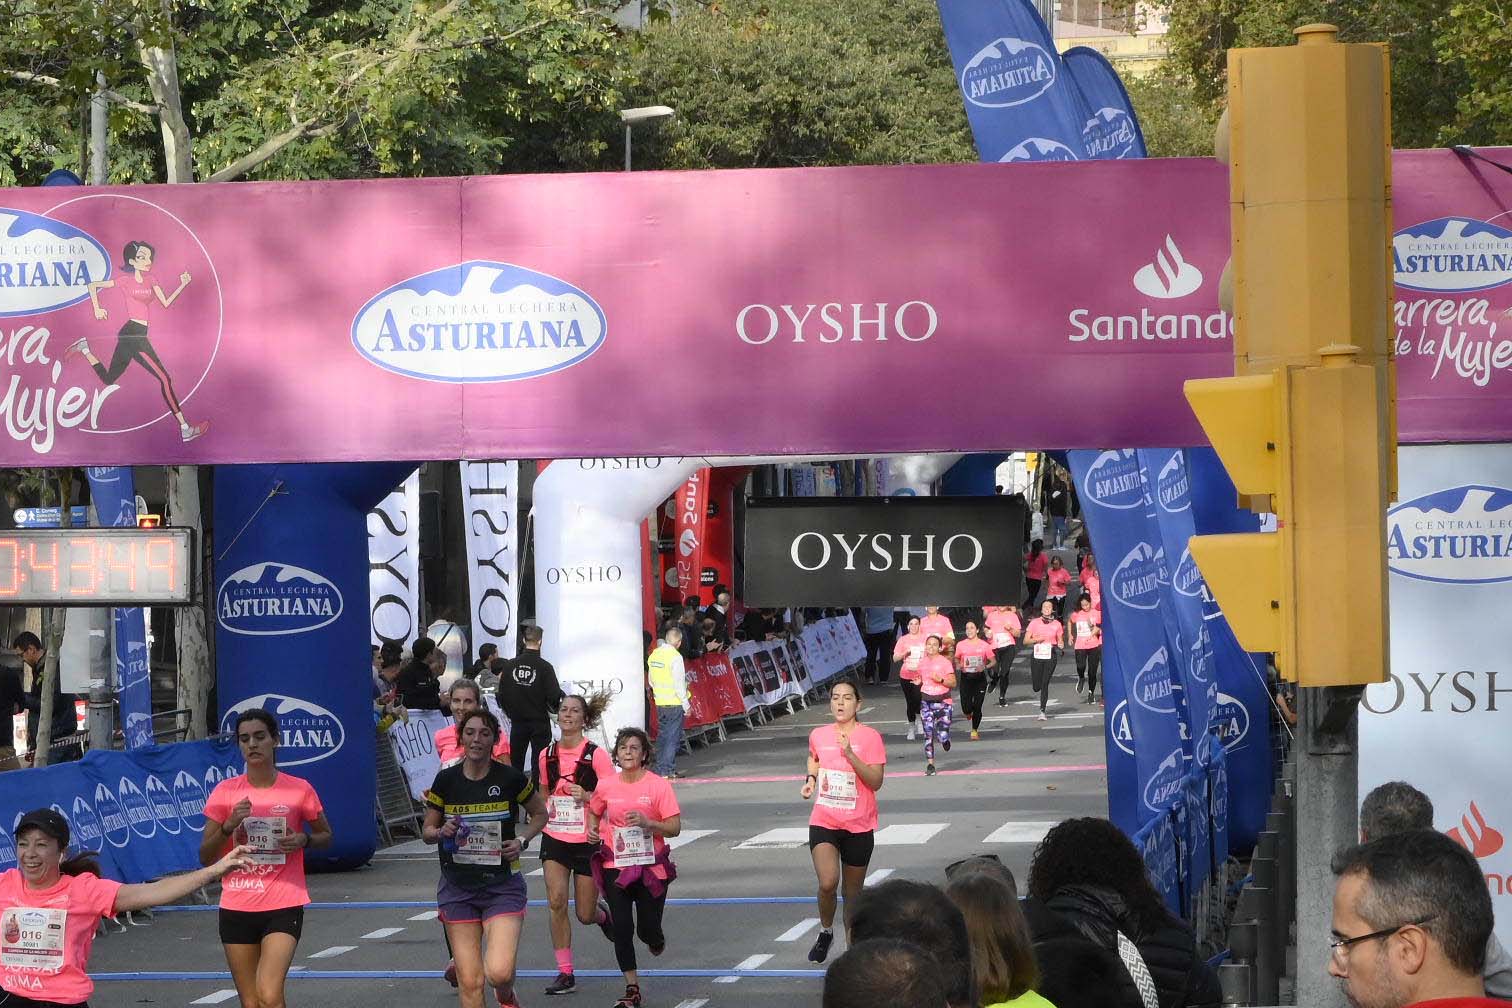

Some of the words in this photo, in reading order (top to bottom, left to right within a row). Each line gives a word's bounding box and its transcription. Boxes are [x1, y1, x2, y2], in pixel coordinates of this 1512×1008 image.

[12, 243, 87, 256] LECHERA
[1408, 243, 1459, 251] CENTRAL
[1464, 242, 1512, 251] LECHER
[409, 303, 490, 318] CENTRAL
[497, 300, 579, 315] LECHERA
[1393, 297, 1489, 327] arrera
[371, 307, 588, 353] ASTURIANA
[735, 300, 939, 345] OYSHO
[1068, 308, 1234, 342] Santand
[1417, 328, 1436, 356] la
[1430, 321, 1512, 387] Muje
[1415, 519, 1483, 530] CENTRAL
[1387, 523, 1512, 561] ASTURI
[790, 531, 984, 573] OYSHO
[546, 564, 623, 585] OYSHO
[233, 585, 278, 597] CENTRAL
[280, 585, 330, 596] LECHERA
[220, 592, 334, 619] ASTURIANA
[518, 669, 531, 679] BP
[1360, 671, 1512, 715] OYSH
[281, 717, 330, 728] LECHERA
[474, 803, 498, 812] TEAM
[229, 877, 265, 889] SUMA
[21, 930, 42, 940] 016
[5, 975, 44, 989] SUMA
